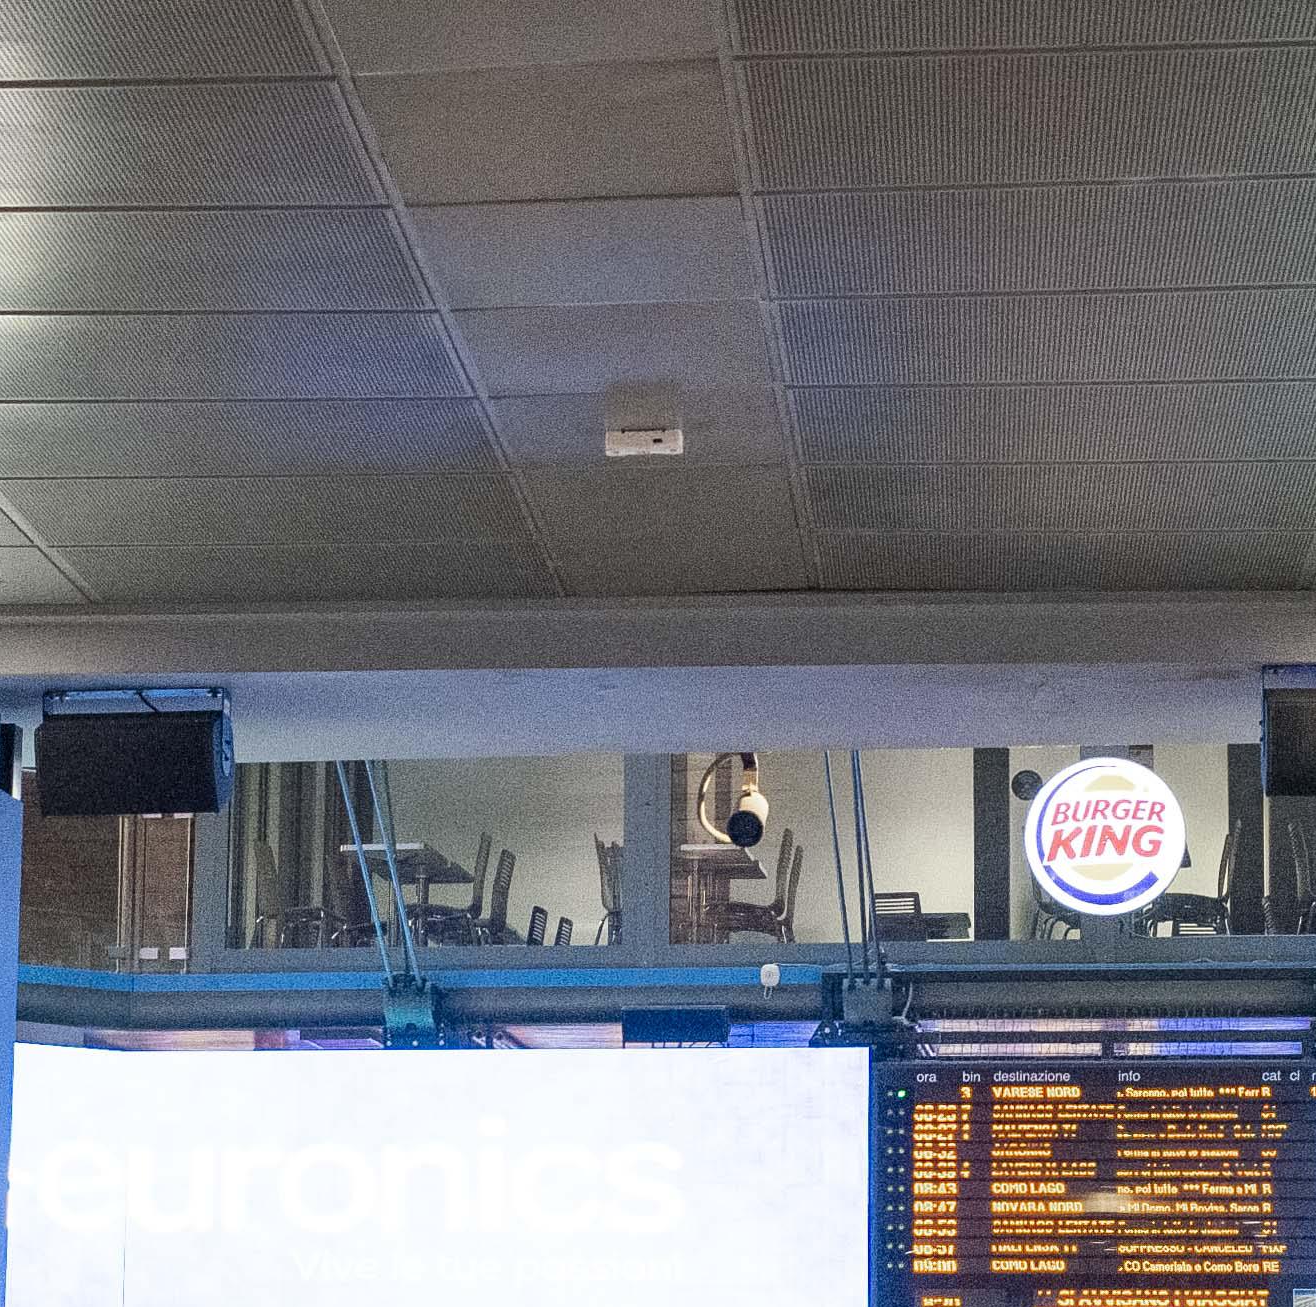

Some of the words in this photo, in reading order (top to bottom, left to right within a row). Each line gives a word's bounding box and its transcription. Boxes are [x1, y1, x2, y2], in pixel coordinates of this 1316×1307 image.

[1051, 798, 1165, 826] BURGER
[1047, 825, 1165, 862] KING
[916, 1073, 937, 1083] ora
[962, 1071, 981, 1082] bin
[993, 1071, 1071, 1082] destinazione
[1118, 1071, 1141, 1082] info
[1262, 1071, 1282, 1081] cat
[992, 1087, 1043, 1099] VARESE
[1046, 1087, 1081, 1099] NORD
[36, 1116, 685, 1237] euronics
[992, 1183, 1028, 1195] COMO
[1030, 1183, 1065, 1194] LAGO
[1262, 1184, 1272, 1194] R
[1262, 1203, 1272, 1213] R
[992, 1261, 1028, 1272] COMO
[1030, 1261, 1066, 1272] LAGO
[1203, 1261, 1233, 1272] Como
[1262, 1261, 1280, 1272] RE
